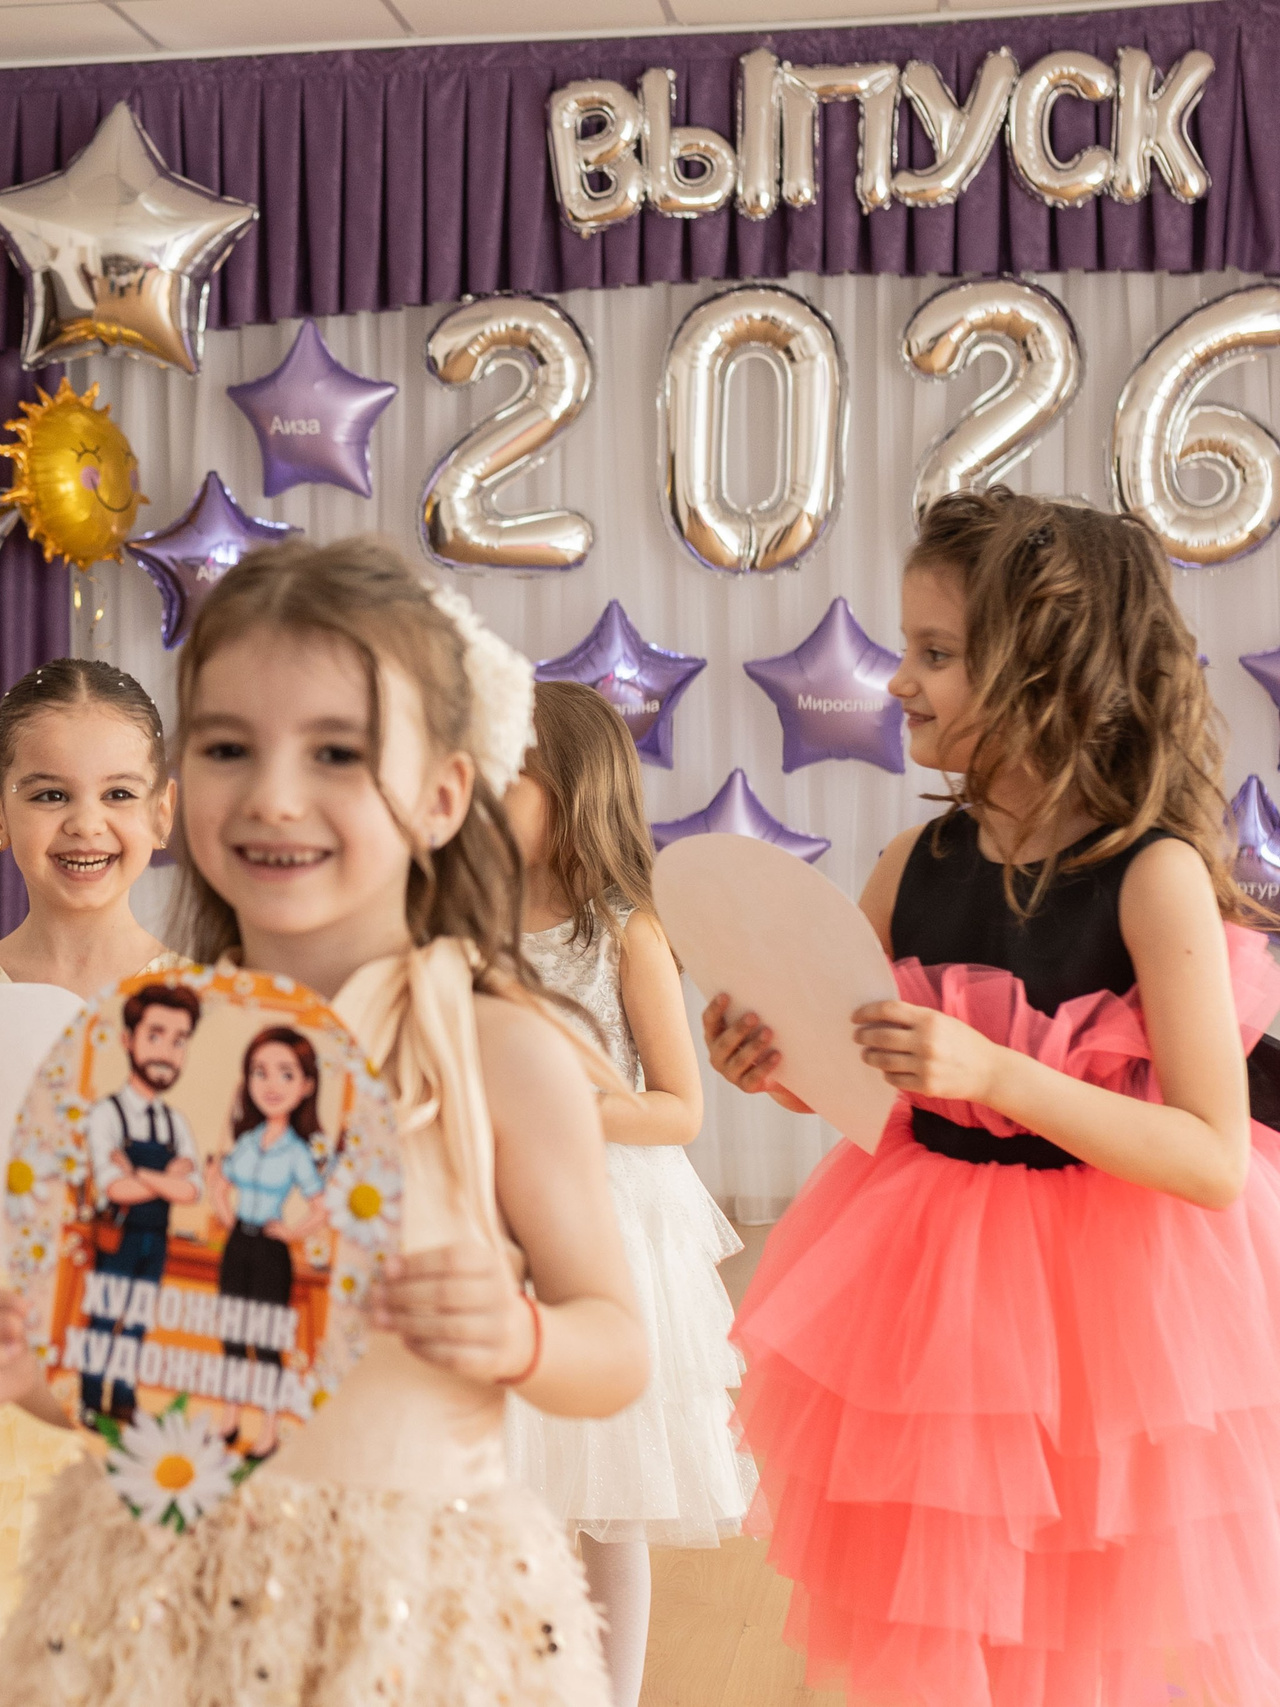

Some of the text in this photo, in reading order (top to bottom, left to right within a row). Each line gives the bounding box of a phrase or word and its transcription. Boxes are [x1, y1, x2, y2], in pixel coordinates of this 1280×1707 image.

[546, 44, 1216, 237] ВЫПУСК
[270, 415, 321, 436] Аиза
[419, 274, 1280, 575] 2026
[797, 693, 884, 715] Мирослав
[82, 1271, 299, 1352] ХУДОЖНИК
